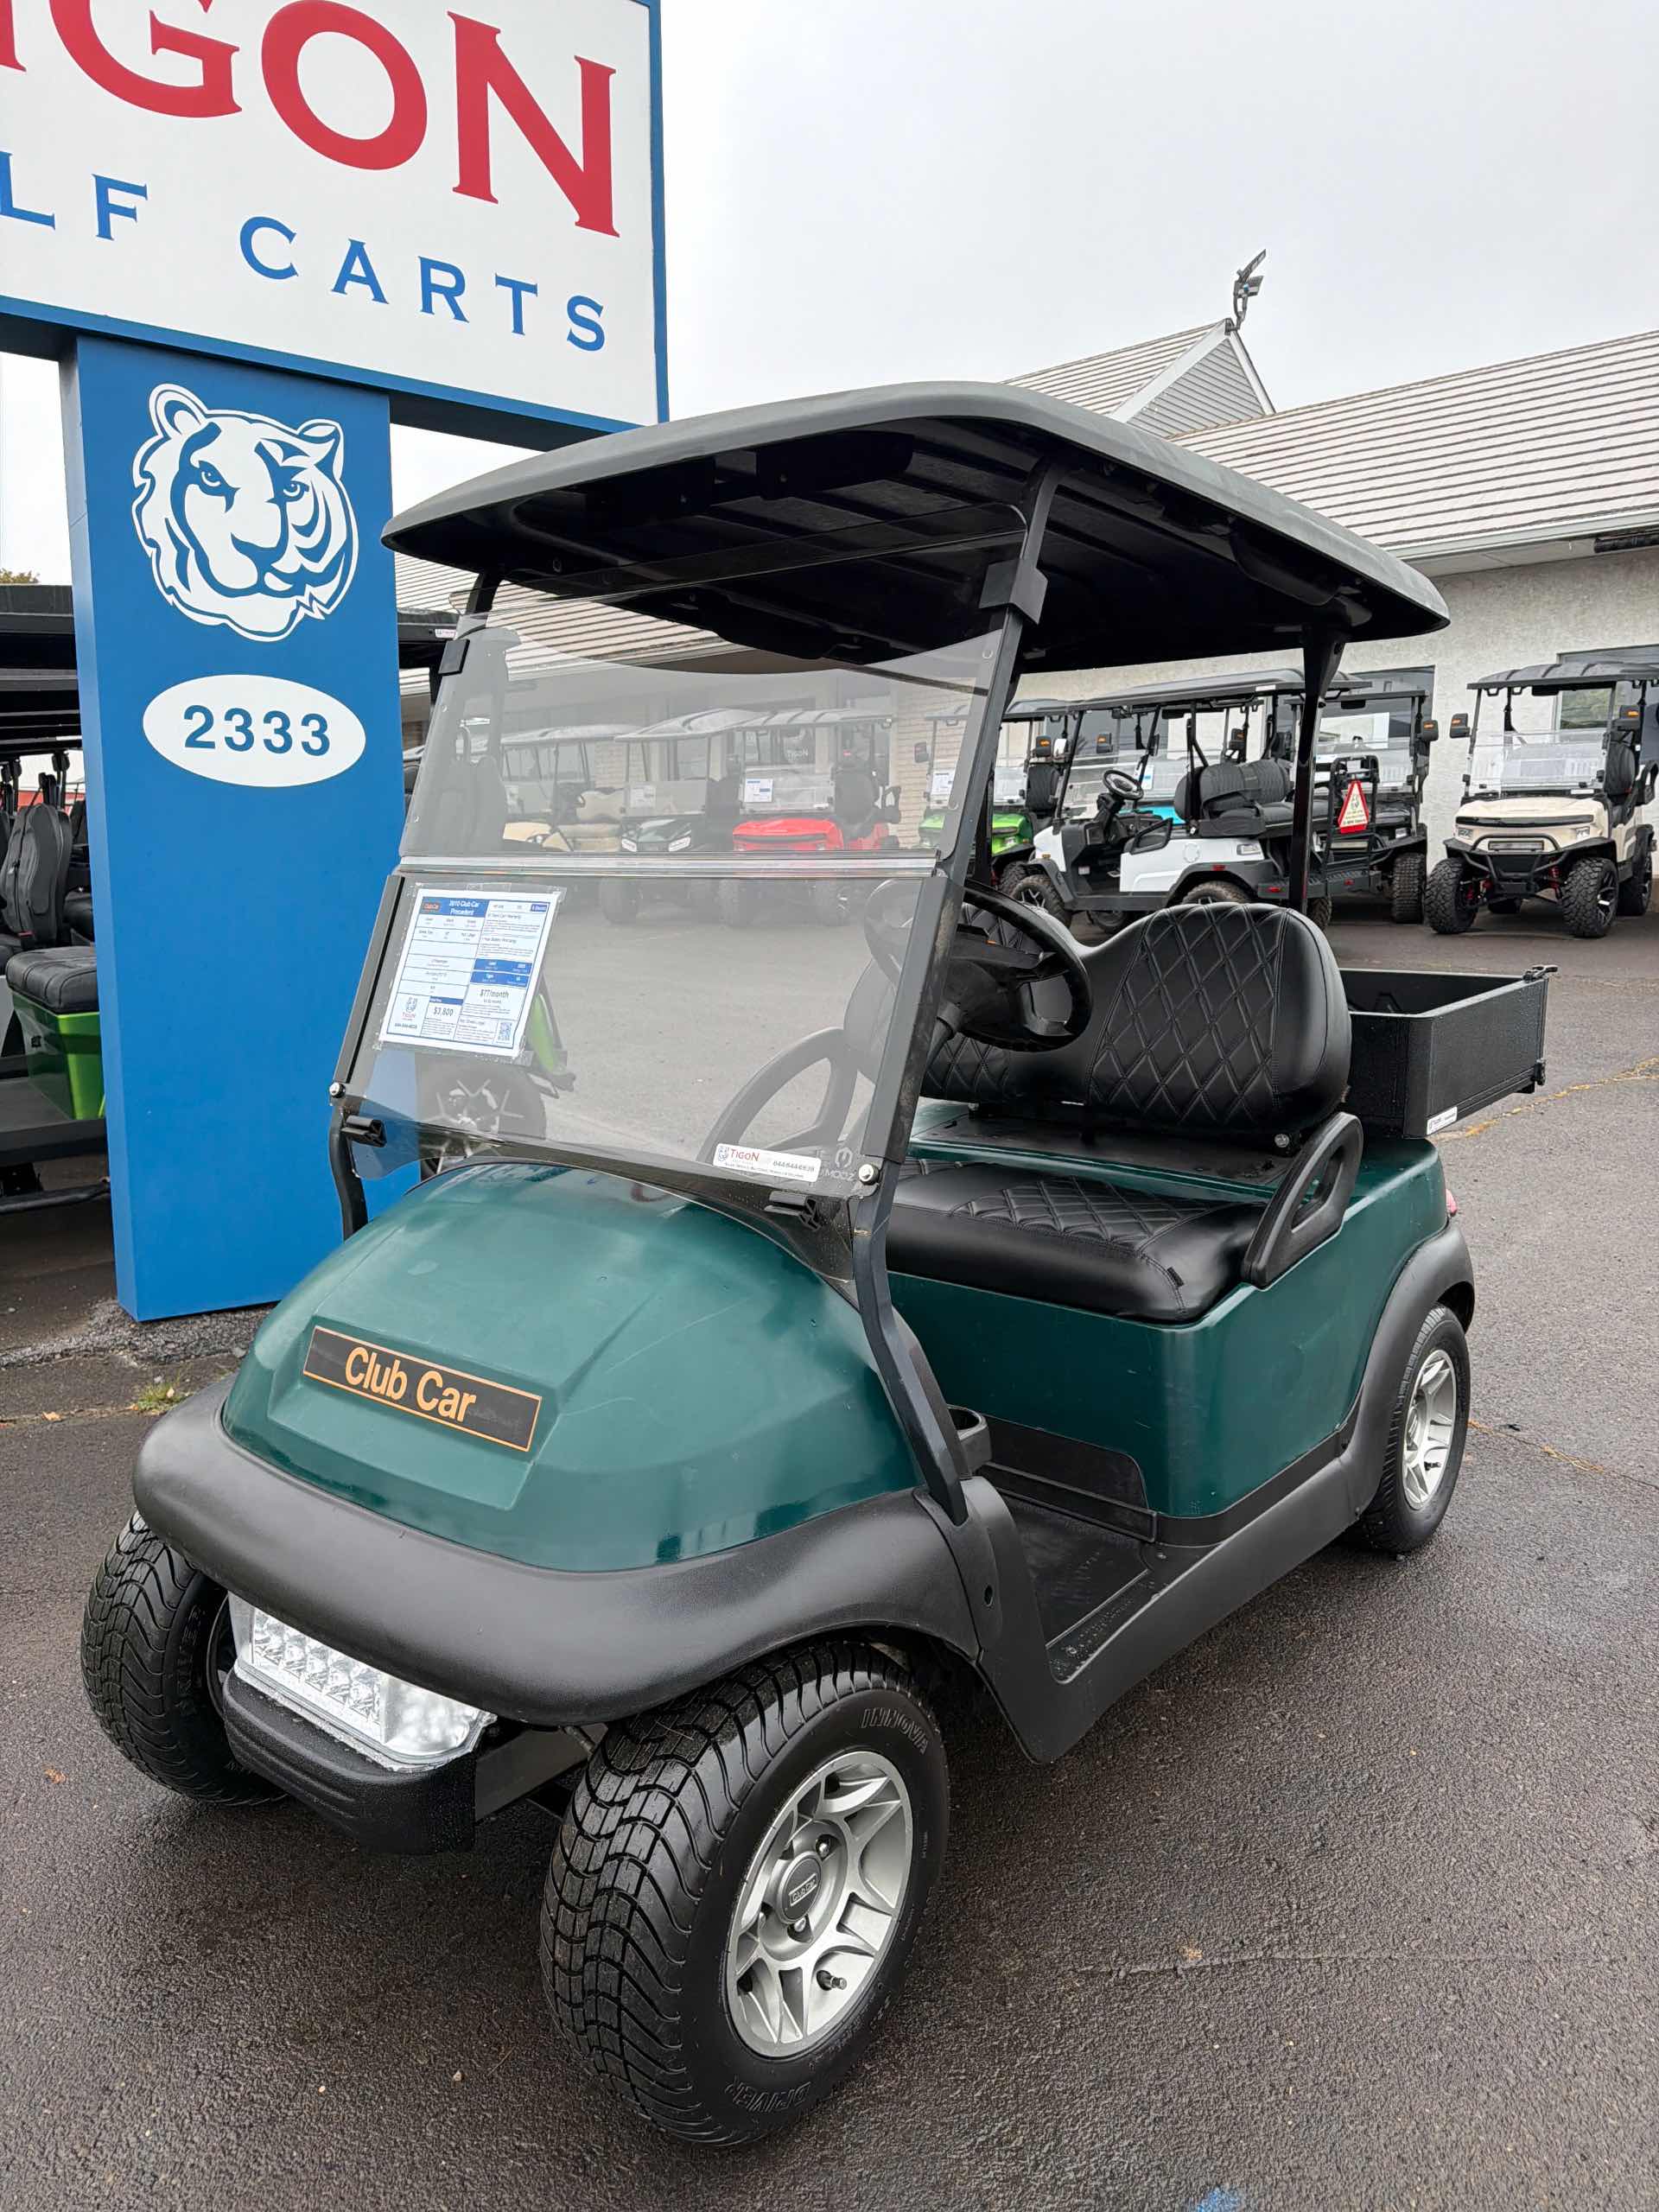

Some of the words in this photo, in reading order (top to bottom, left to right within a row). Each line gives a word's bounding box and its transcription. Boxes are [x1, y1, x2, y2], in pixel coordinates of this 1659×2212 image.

[0, 0, 620, 238] GON
[239, 216, 606, 352] CARTS
[183, 704, 330, 756] 2333
[729, 1148, 760, 1162] TIGON
[346, 1346, 408, 1400] Club
[416, 1370, 476, 1422] Car
